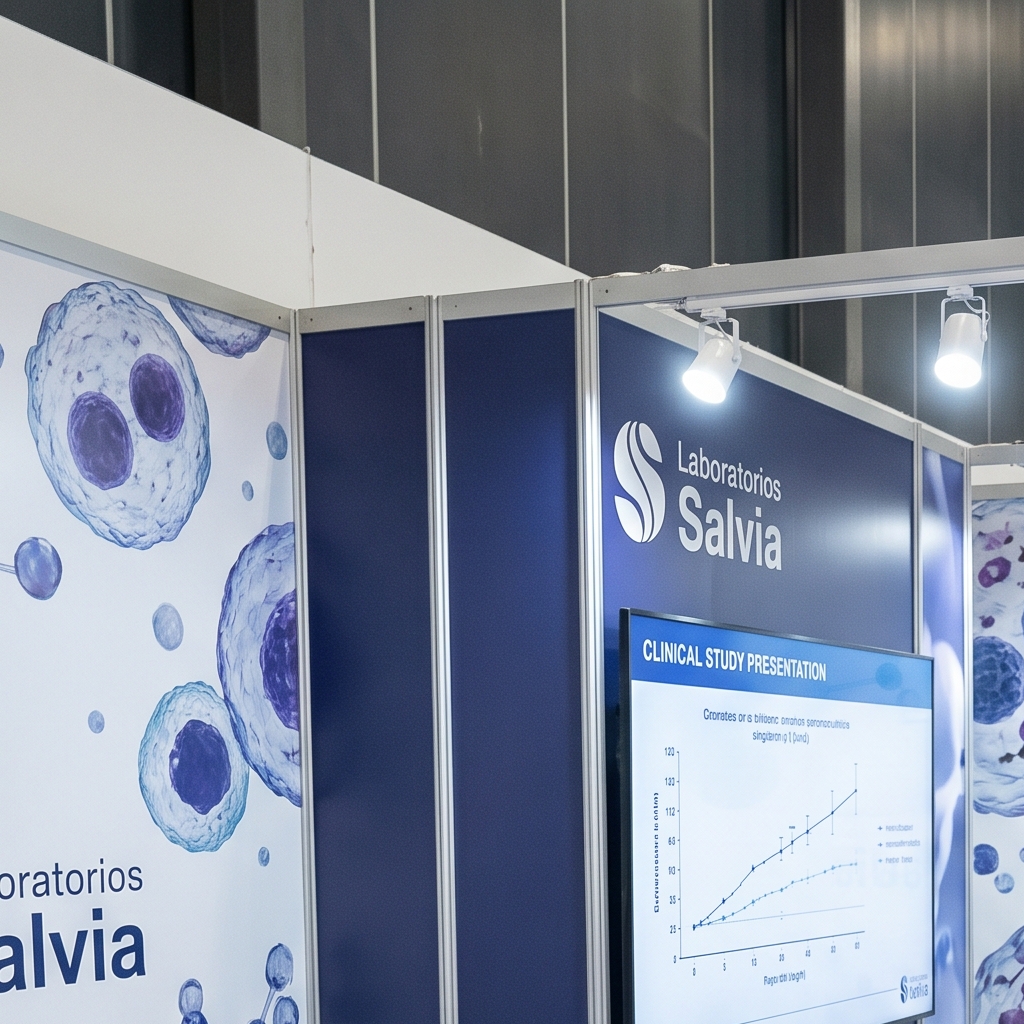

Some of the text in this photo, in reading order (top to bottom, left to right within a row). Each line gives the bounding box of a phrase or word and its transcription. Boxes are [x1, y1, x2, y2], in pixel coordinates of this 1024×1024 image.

[677, 440, 782, 502] Laboratorios
[677, 485, 783, 571] Salvia
[642, 638, 827, 682] CLINICAL STUDY PRESENTATION
